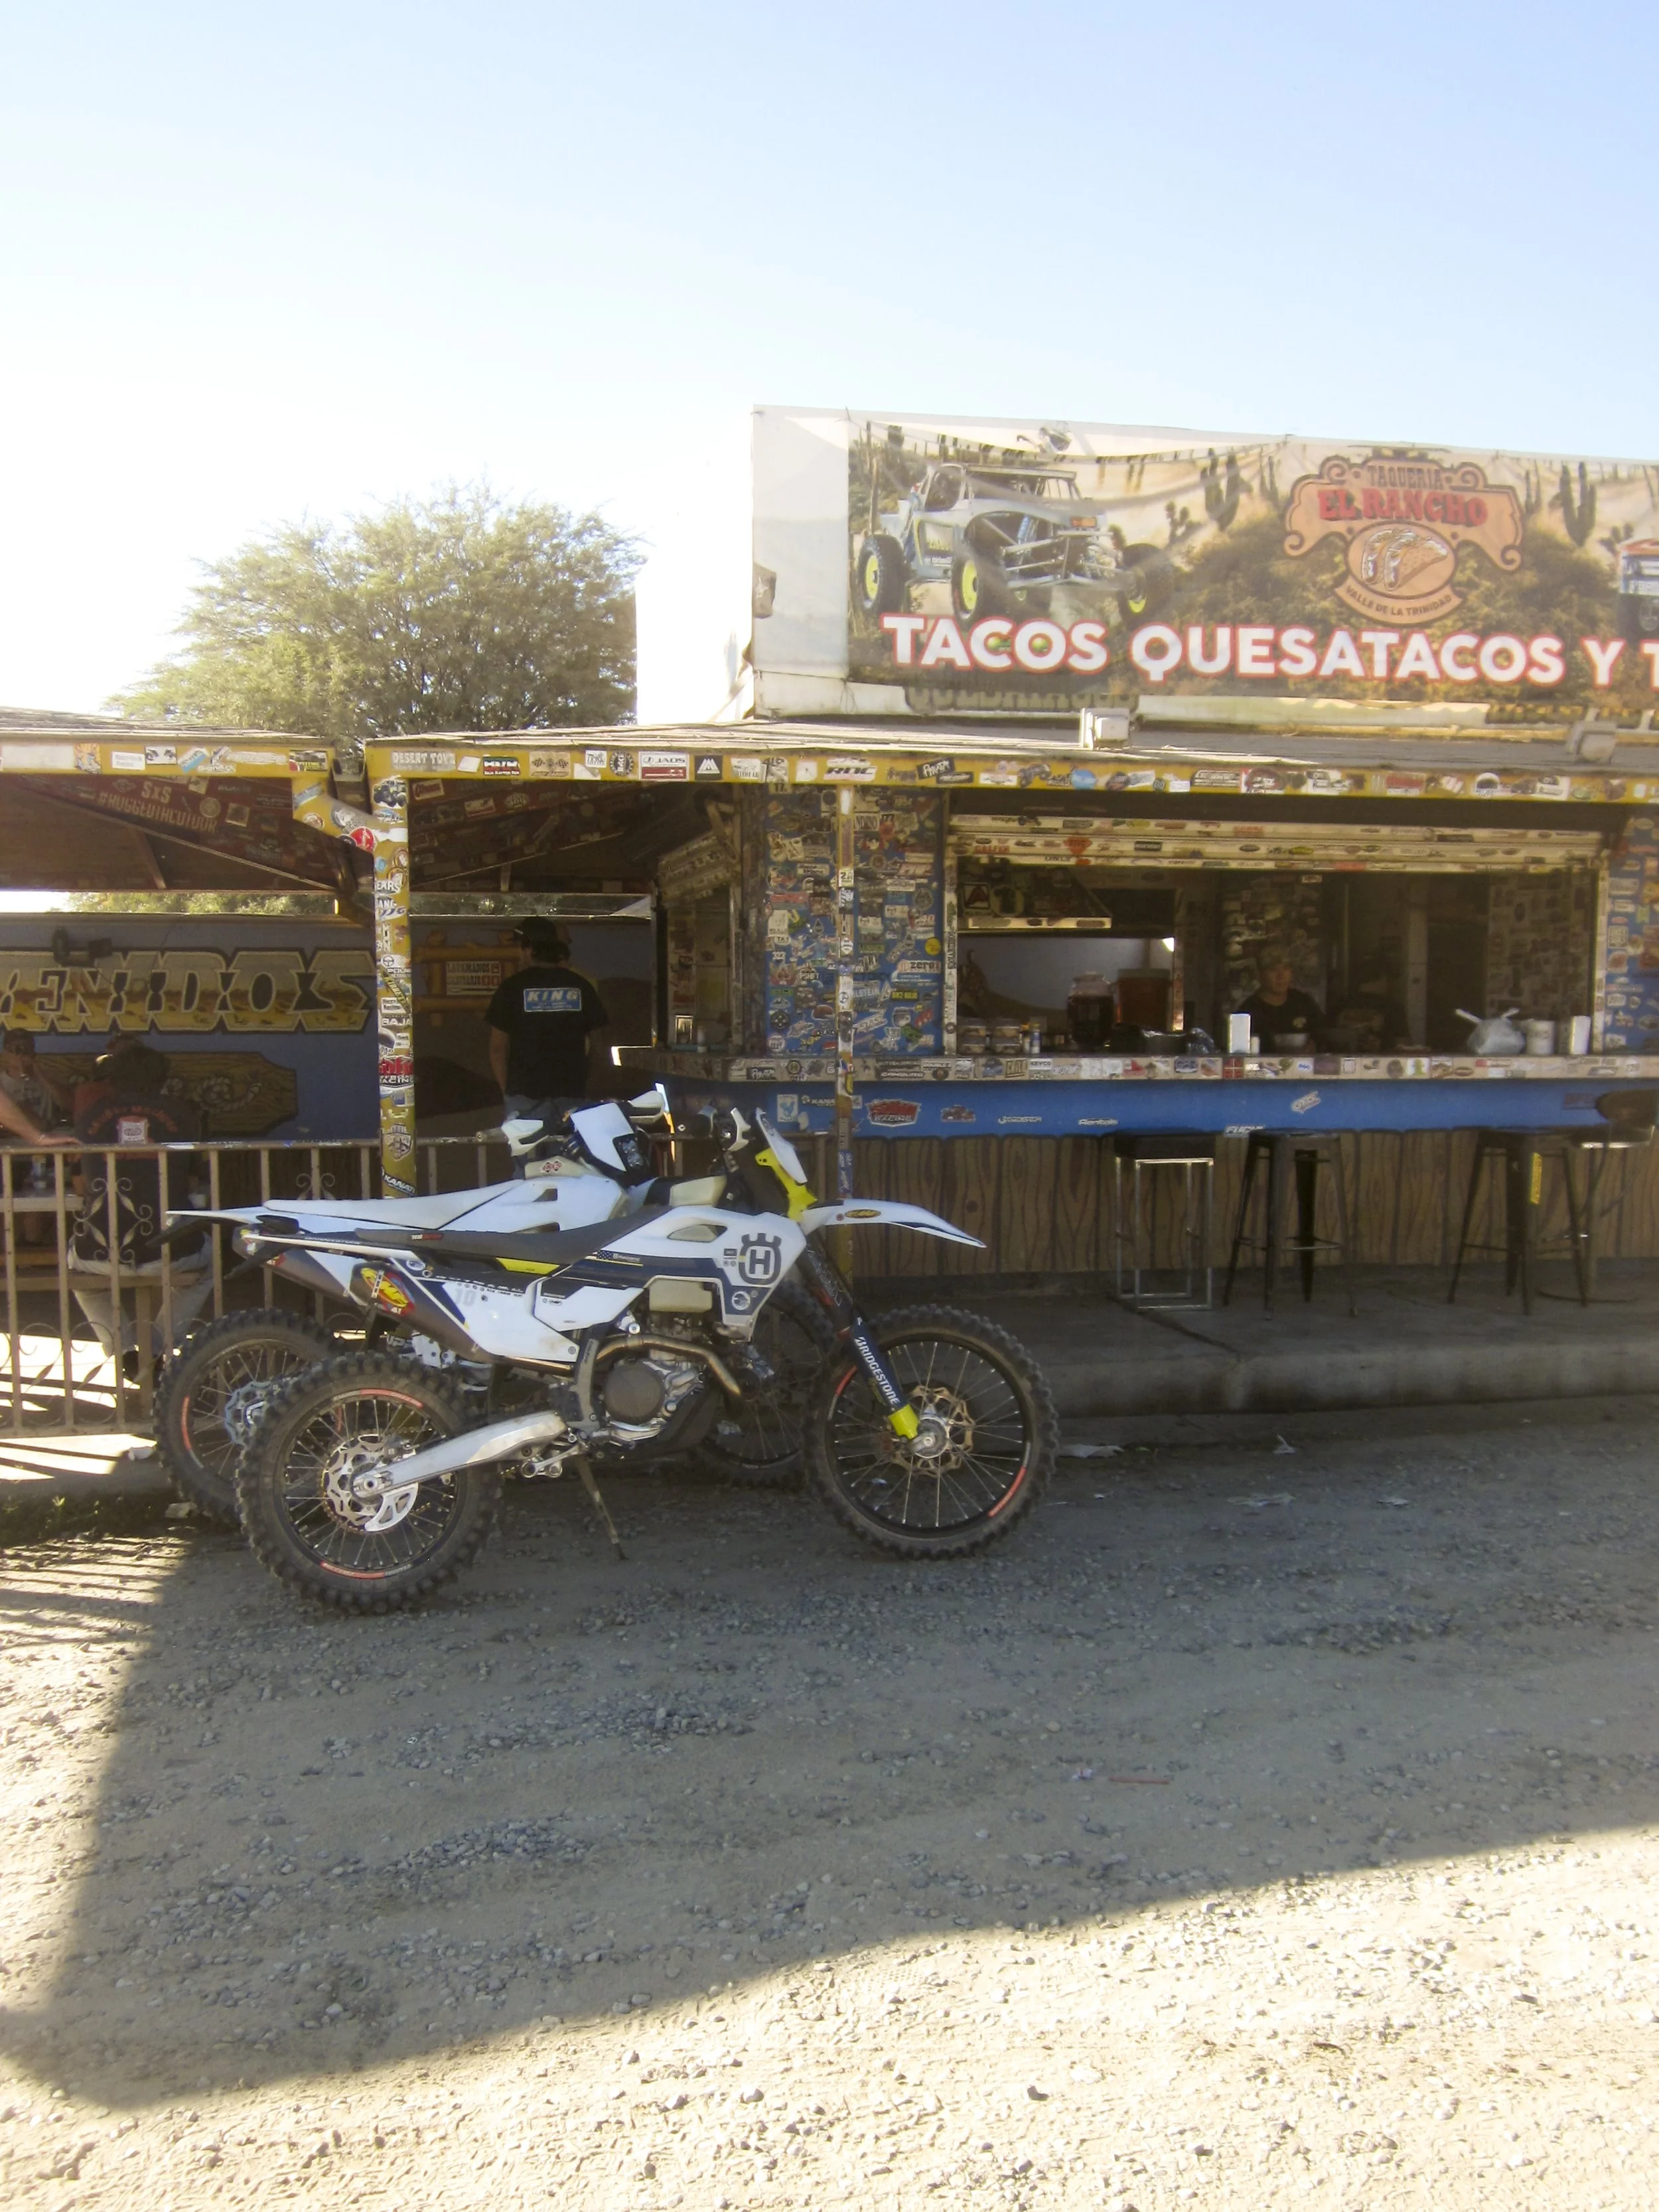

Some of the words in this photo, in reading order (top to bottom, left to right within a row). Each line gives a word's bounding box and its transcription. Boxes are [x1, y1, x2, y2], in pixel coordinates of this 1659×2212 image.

[1367, 465, 1444, 490] TAQUERIA
[1317, 488, 1360, 521] EL
[1362, 488, 1488, 527] RANCHO
[1346, 585, 1374, 611] VALLE
[1375, 604, 1388, 615] DE
[1390, 607, 1405, 617] LA
[1406, 594, 1453, 617] TRINIDAD
[881, 613, 1109, 673] TACOS
[1131, 623, 1565, 686] QUESATACOS
[1581, 637, 1624, 687] Y
[0, 950, 376, 1031] ENIDOS
[527, 990, 579, 1001] KING
[854, 1336, 901, 1405] BRIDGESTONE
